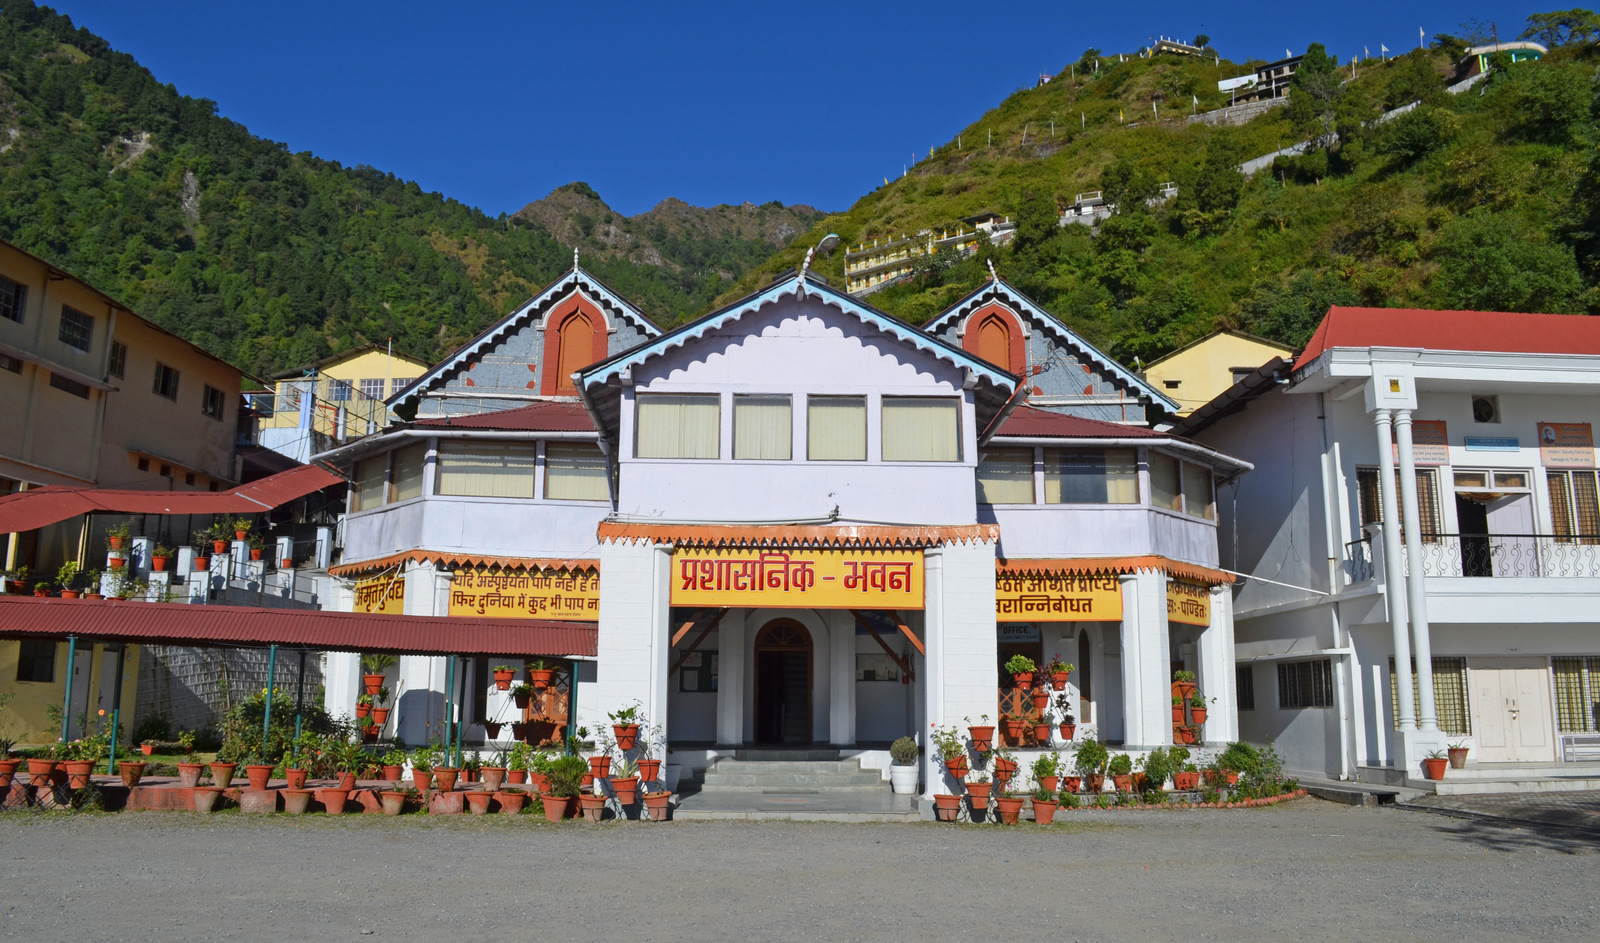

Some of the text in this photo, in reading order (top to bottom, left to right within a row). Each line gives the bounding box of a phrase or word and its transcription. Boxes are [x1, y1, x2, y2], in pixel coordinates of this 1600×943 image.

[453, 573, 473, 589] यदि
[531, 577, 552, 590] पाप
[680, 553, 814, 592] प्रशासनिक
[843, 561, 915, 593] भवन
[452, 591, 476, 607] फिर
[476, 593, 515, 614] दुनिया
[518, 593, 528, 609] में
[550, 594, 563, 610] भी
[564, 597, 585, 611] पाप
